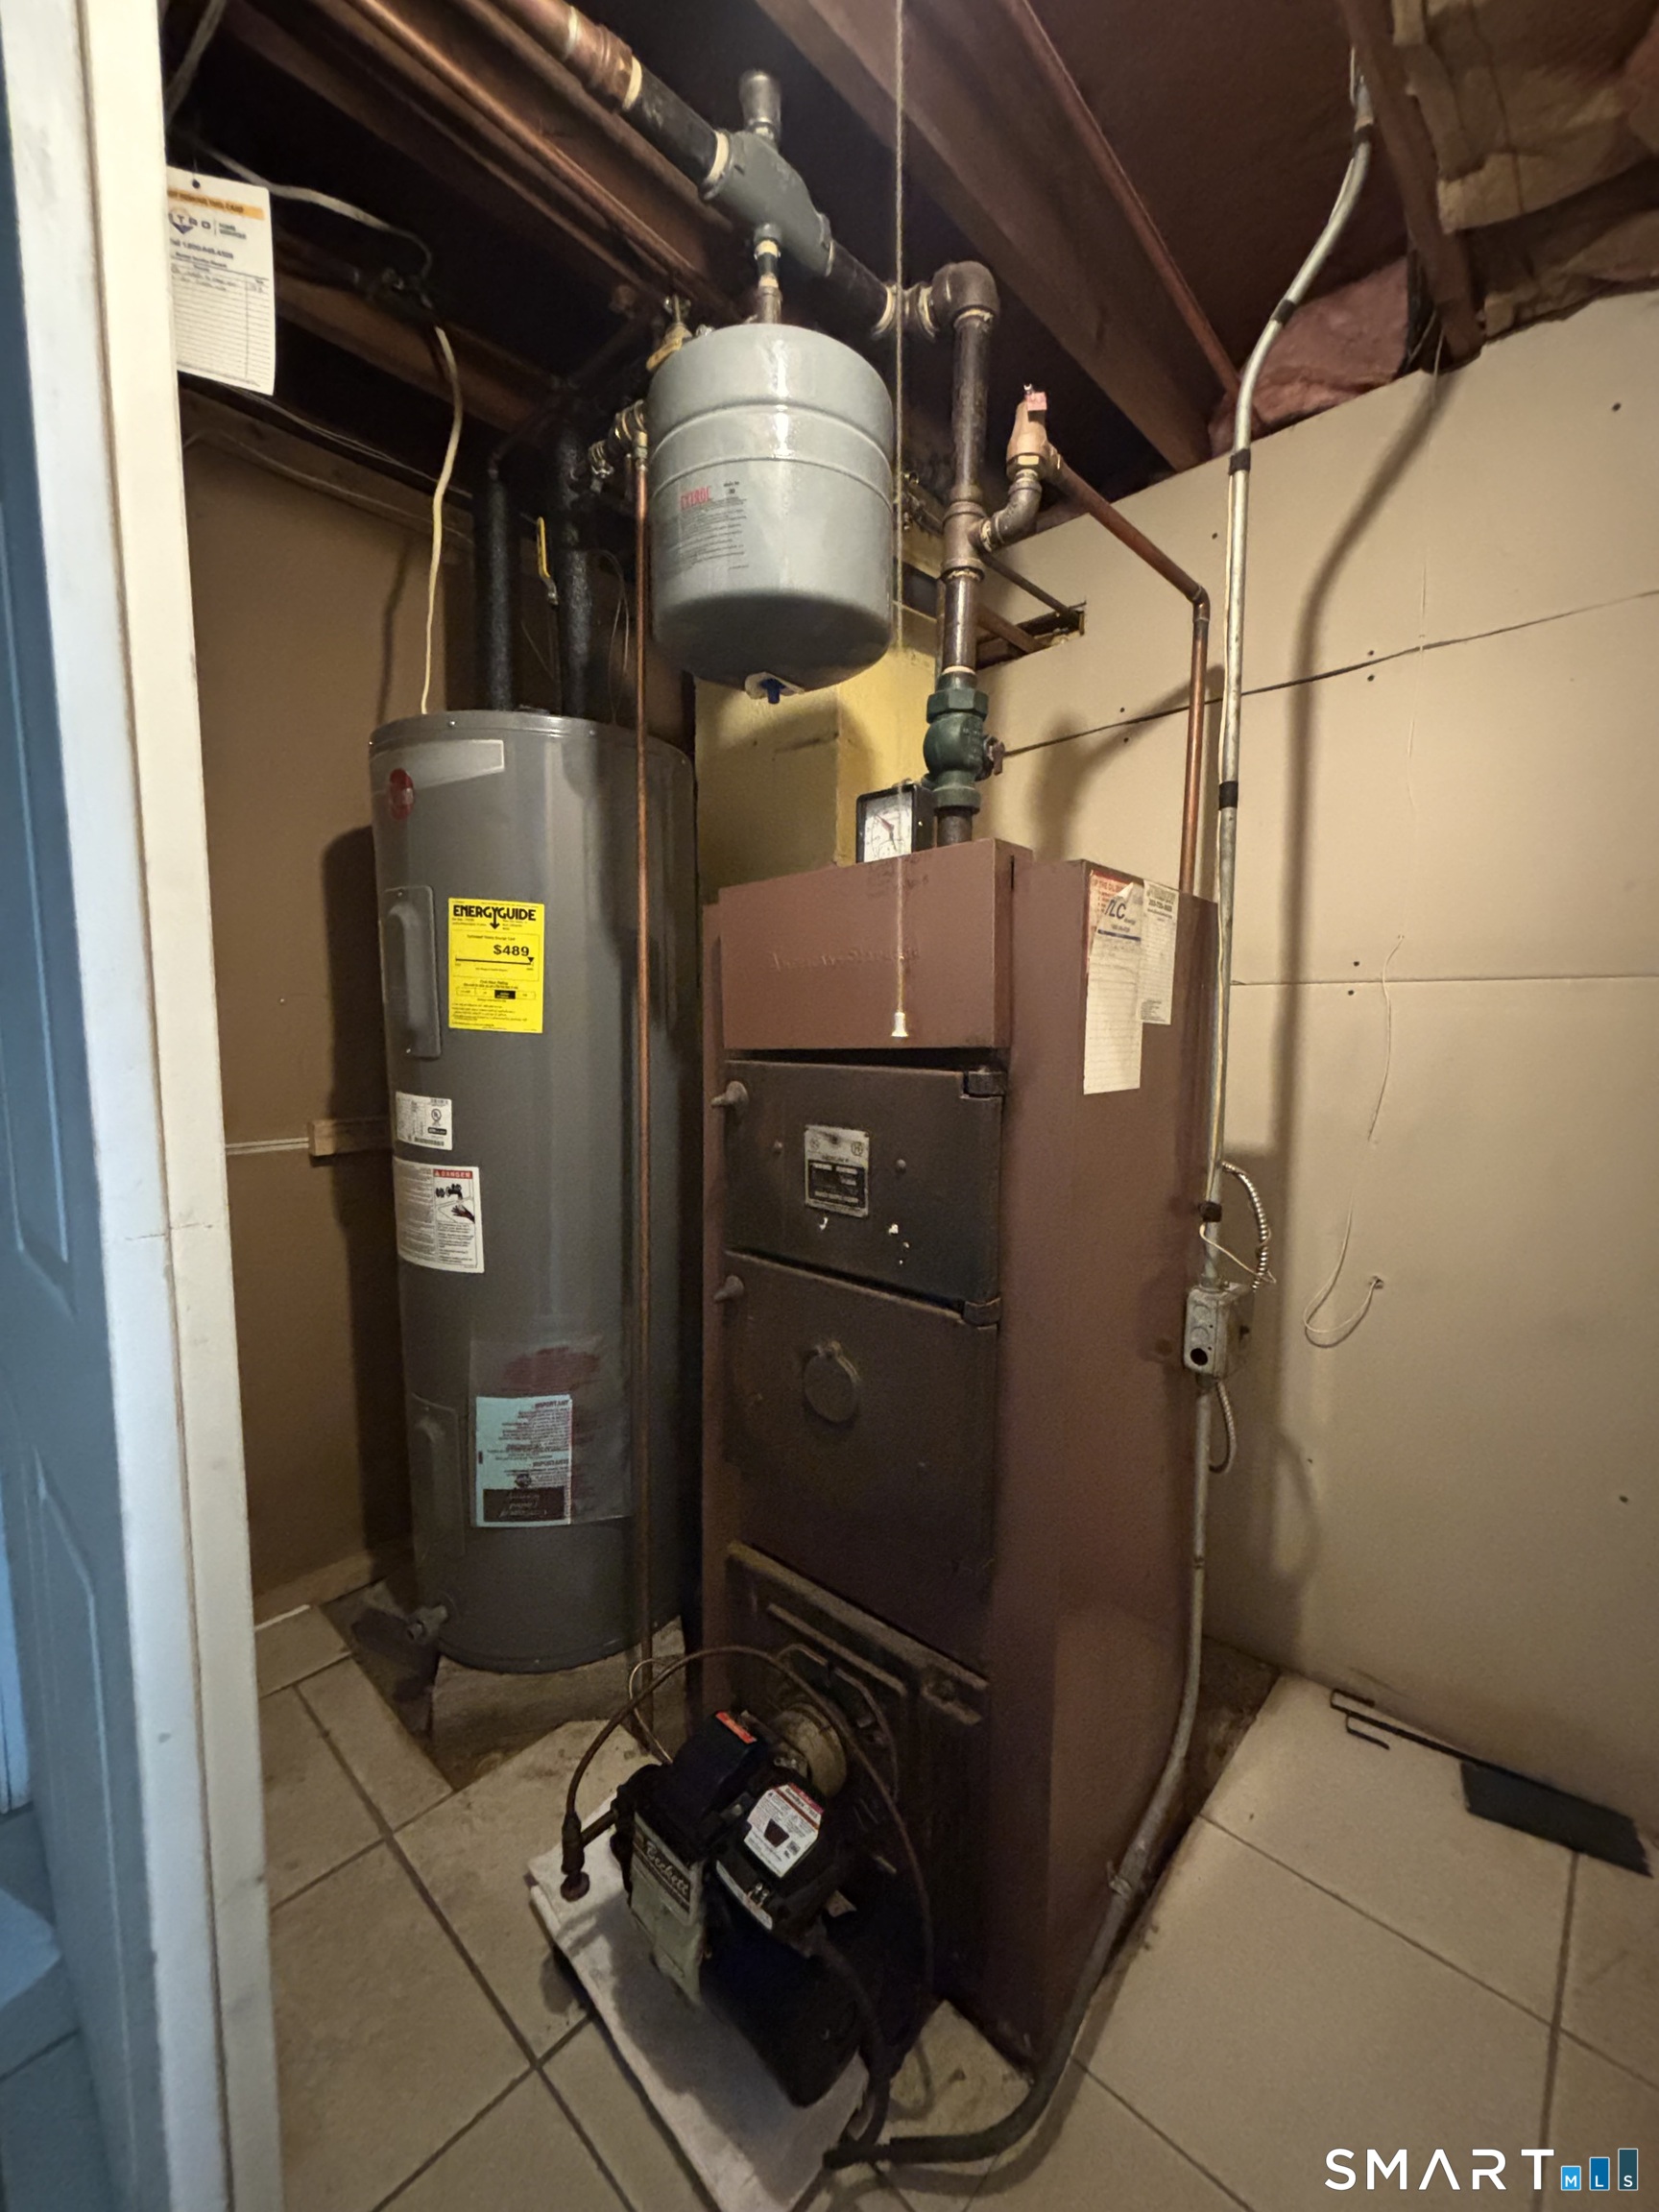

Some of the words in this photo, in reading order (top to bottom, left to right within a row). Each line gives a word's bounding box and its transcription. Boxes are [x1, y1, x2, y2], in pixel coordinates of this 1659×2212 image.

[453, 904, 537, 922] ENERGYGUIDE
[493, 944, 530, 957] $489
[645, 1839, 689, 1896] Beckett
